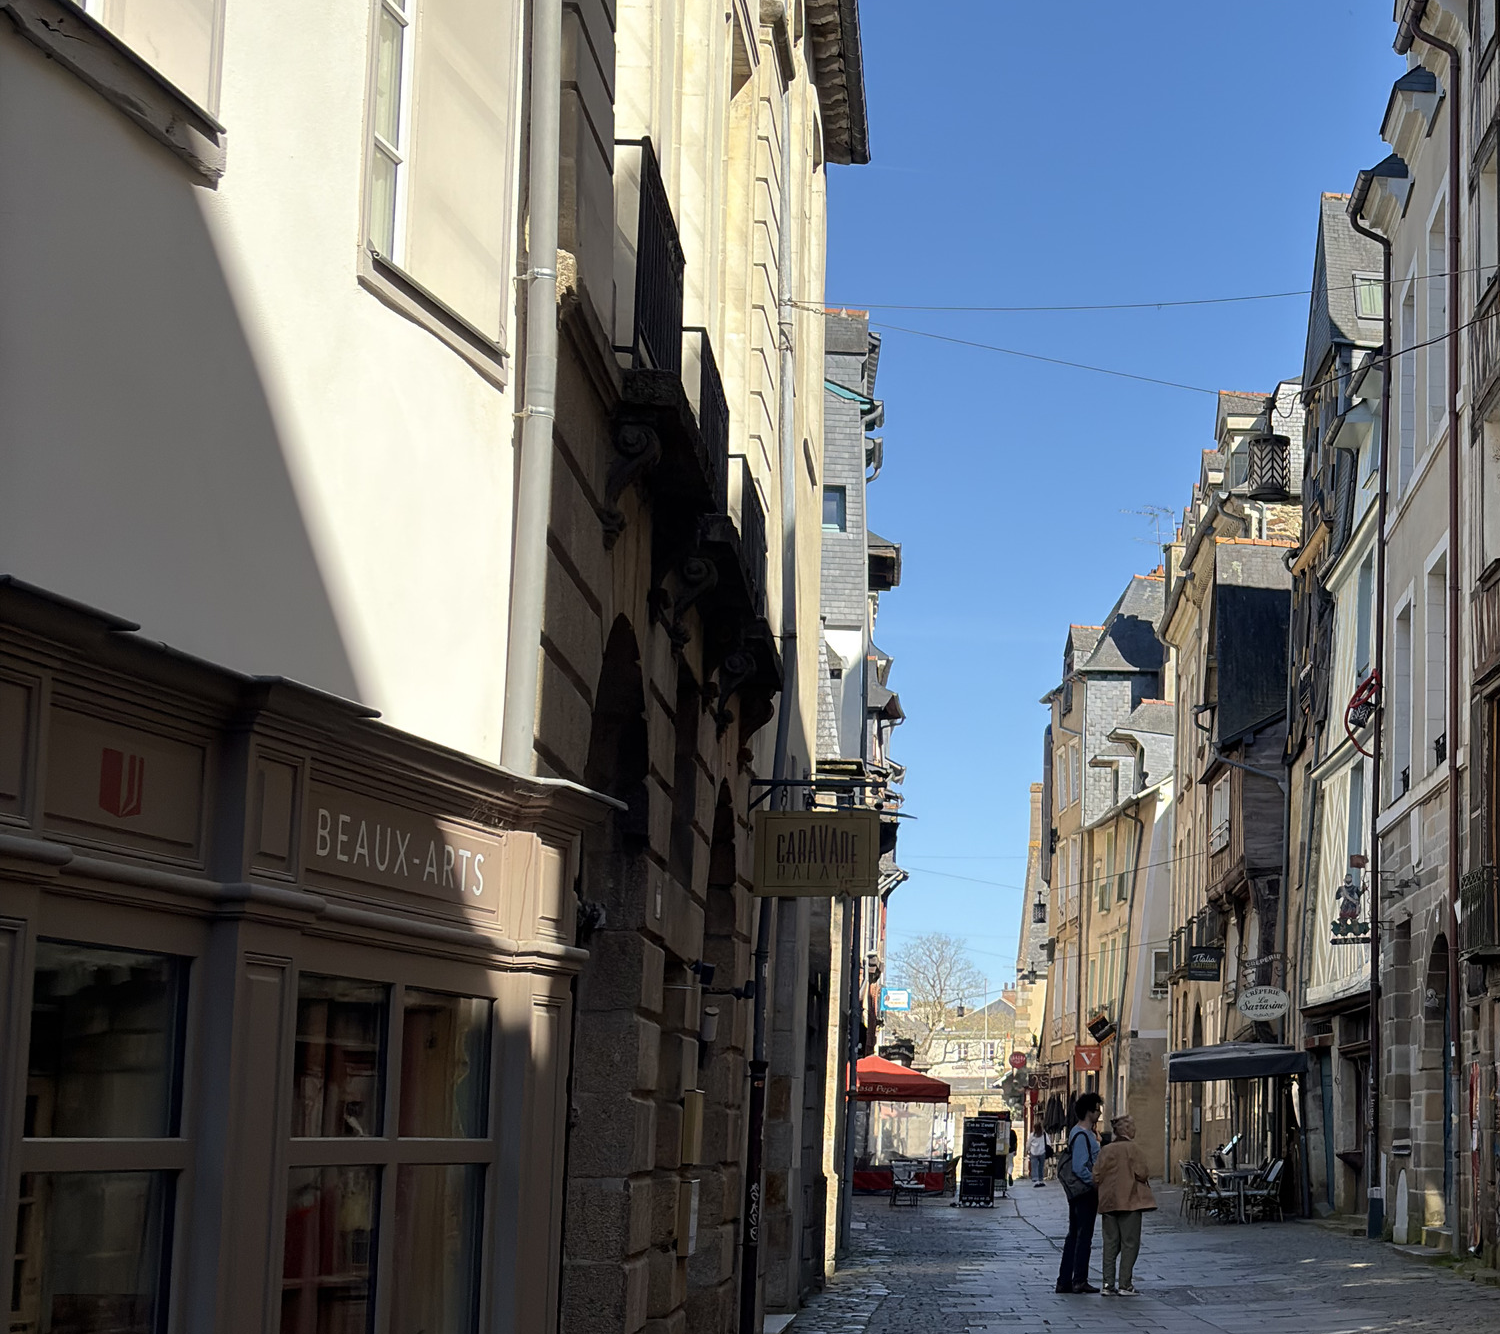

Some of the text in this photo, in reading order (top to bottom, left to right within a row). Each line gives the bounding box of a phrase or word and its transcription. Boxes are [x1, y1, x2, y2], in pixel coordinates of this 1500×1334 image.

[316, 808, 485, 896] BEAUX-ARTS
[1240, 1000, 1286, 1012] Sarrasine
[1079, 1052, 1096, 1066] V
